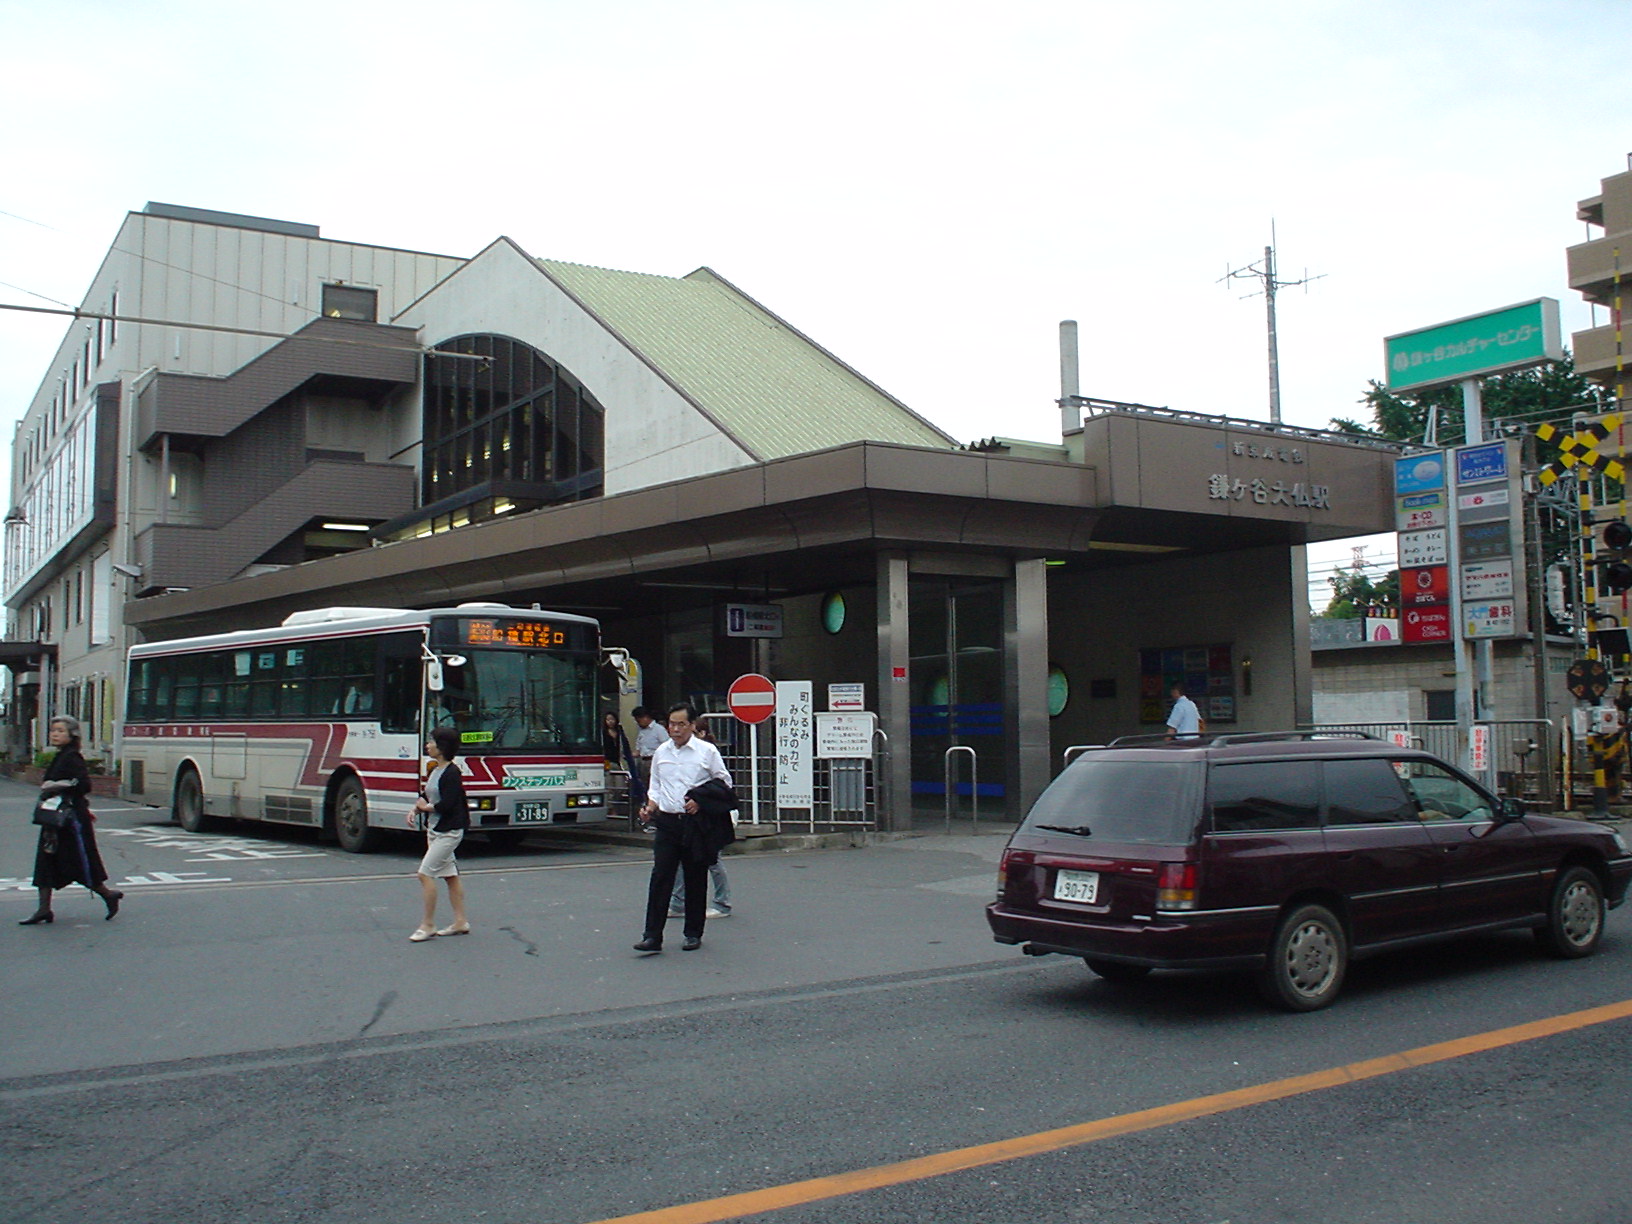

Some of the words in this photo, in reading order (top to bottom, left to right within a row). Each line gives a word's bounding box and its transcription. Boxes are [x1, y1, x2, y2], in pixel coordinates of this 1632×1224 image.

[789, 704, 799, 772] みんなの力で
[800, 691, 810, 741] 町ぐるみ
[779, 717, 789, 785] 非行防止
[502, 775, 565, 788] ワンステップバス
